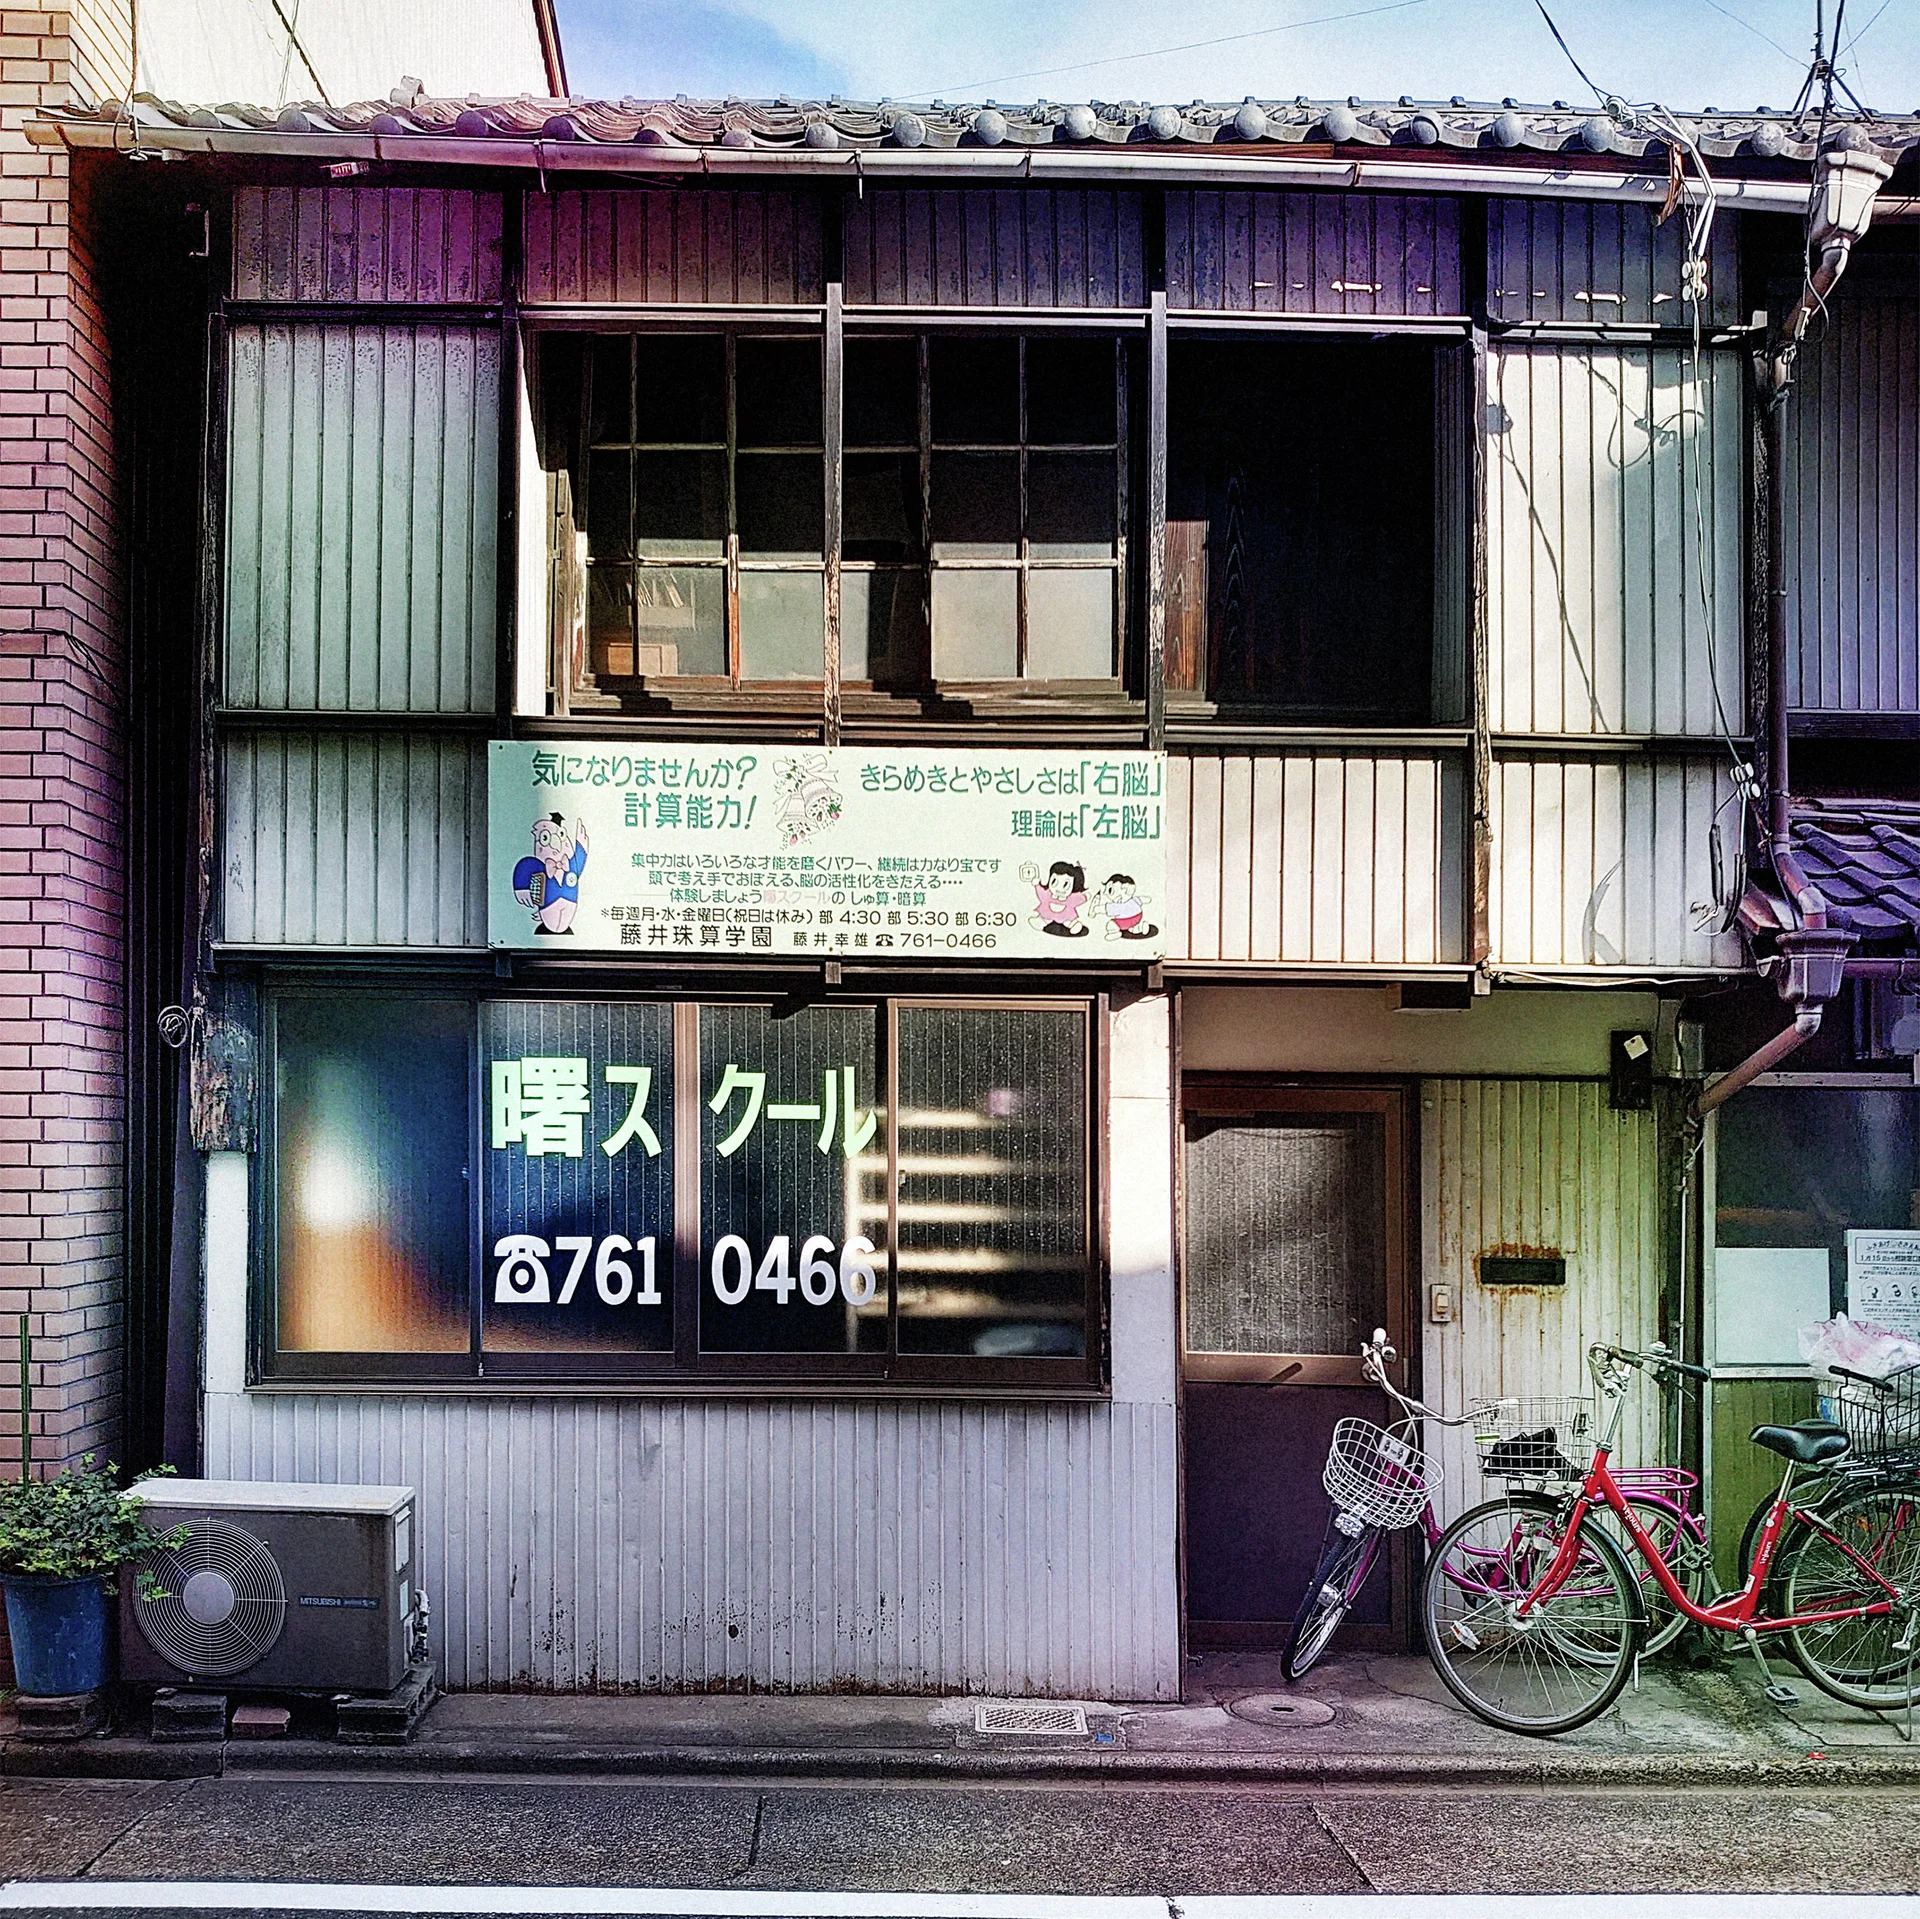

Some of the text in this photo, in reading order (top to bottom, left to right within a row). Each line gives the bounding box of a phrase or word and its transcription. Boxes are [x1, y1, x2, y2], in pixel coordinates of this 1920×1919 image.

[532, 750, 758, 790] 気になりませんか？
[860, 760, 1162, 797] きらめきとやさしさは「右脳」
[624, 792, 758, 830] 計算能力！
[1011, 803, 1161, 840] 理論は「左脳」
[620, 923, 772, 948] 藤井珠算学園
[900, 933, 997, 948] 761-0466
[819, 909, 833, 925] 部
[839, 910, 881, 925] 4:30
[887, 910, 901, 926] 部
[907, 911, 949, 927] 5:30
[955, 911, 969, 927] 部
[975, 911, 1017, 927] 6:30
[555, 1234, 877, 1306] 761 0466
[300, 1597, 341, 1606] MITSUBISHI
